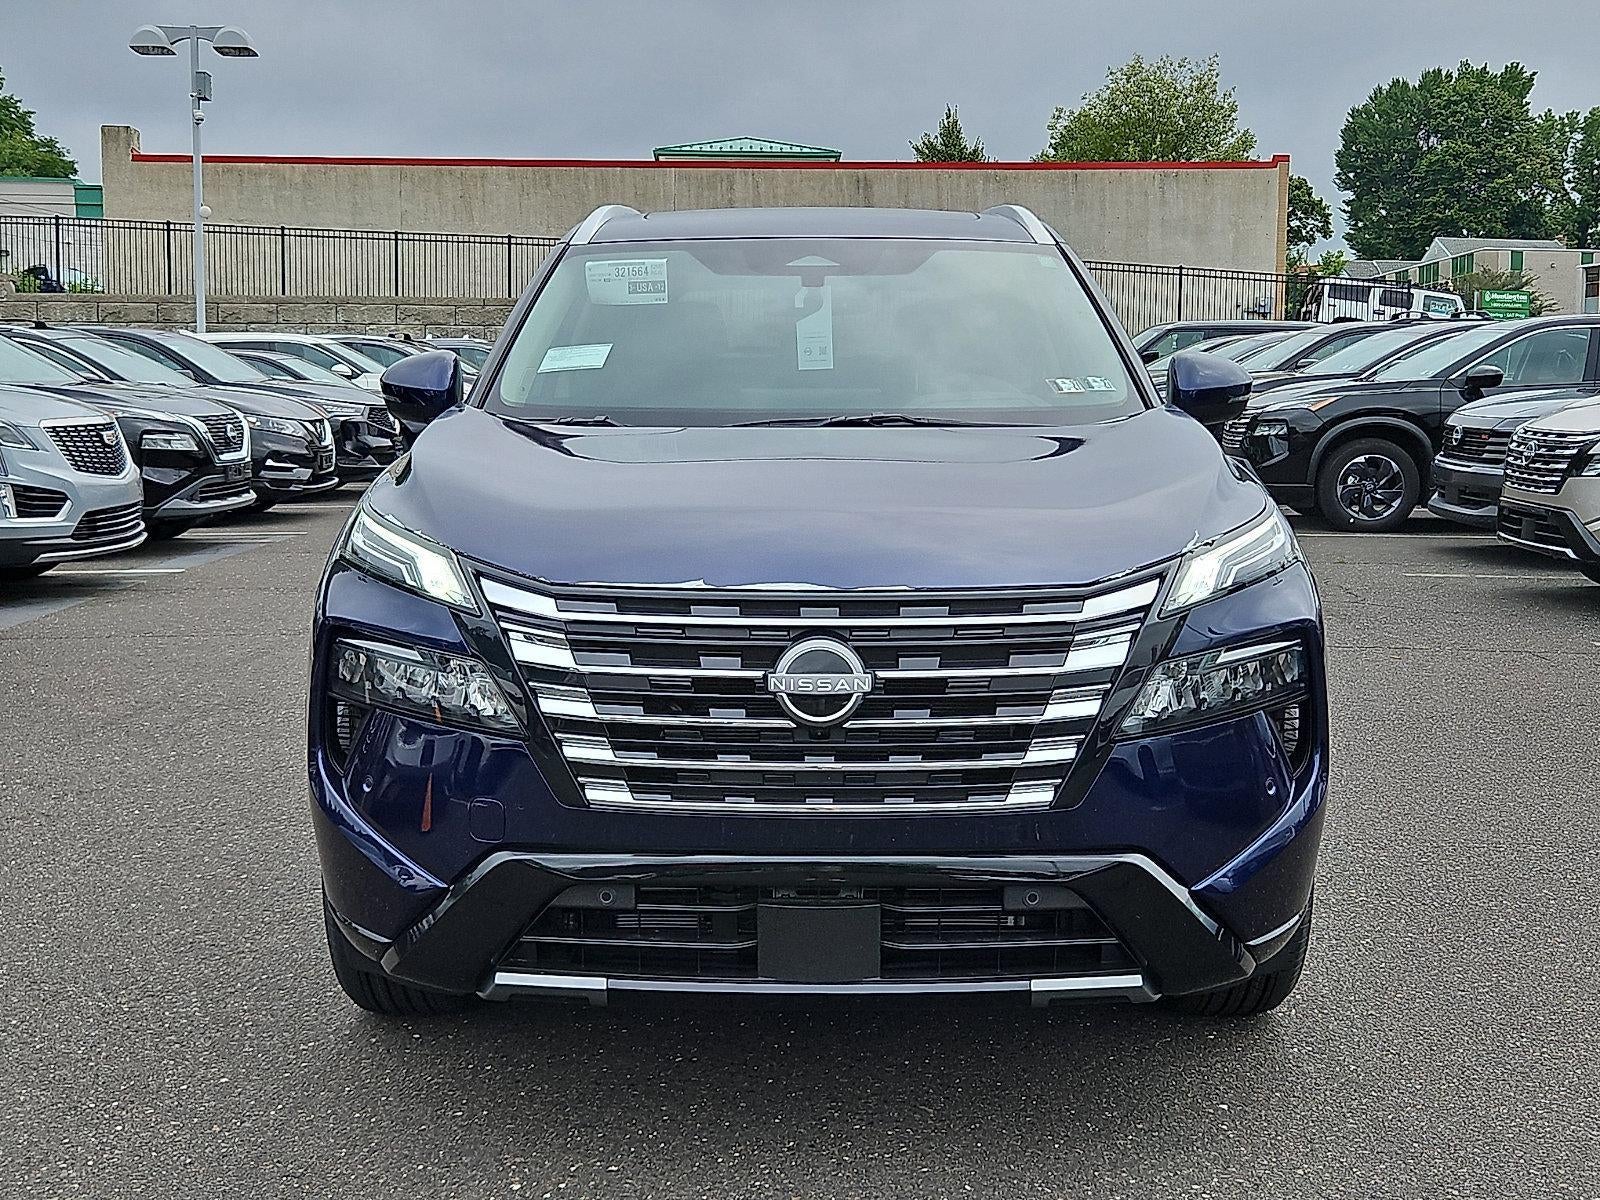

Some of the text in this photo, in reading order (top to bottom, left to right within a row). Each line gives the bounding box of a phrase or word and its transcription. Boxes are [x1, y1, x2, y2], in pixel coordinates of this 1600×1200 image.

[614, 267, 649, 278] 321564
[636, 282, 653, 291] USA
[1491, 293, 1528, 301] Huntington
[770, 678, 869, 691] NISSAN
